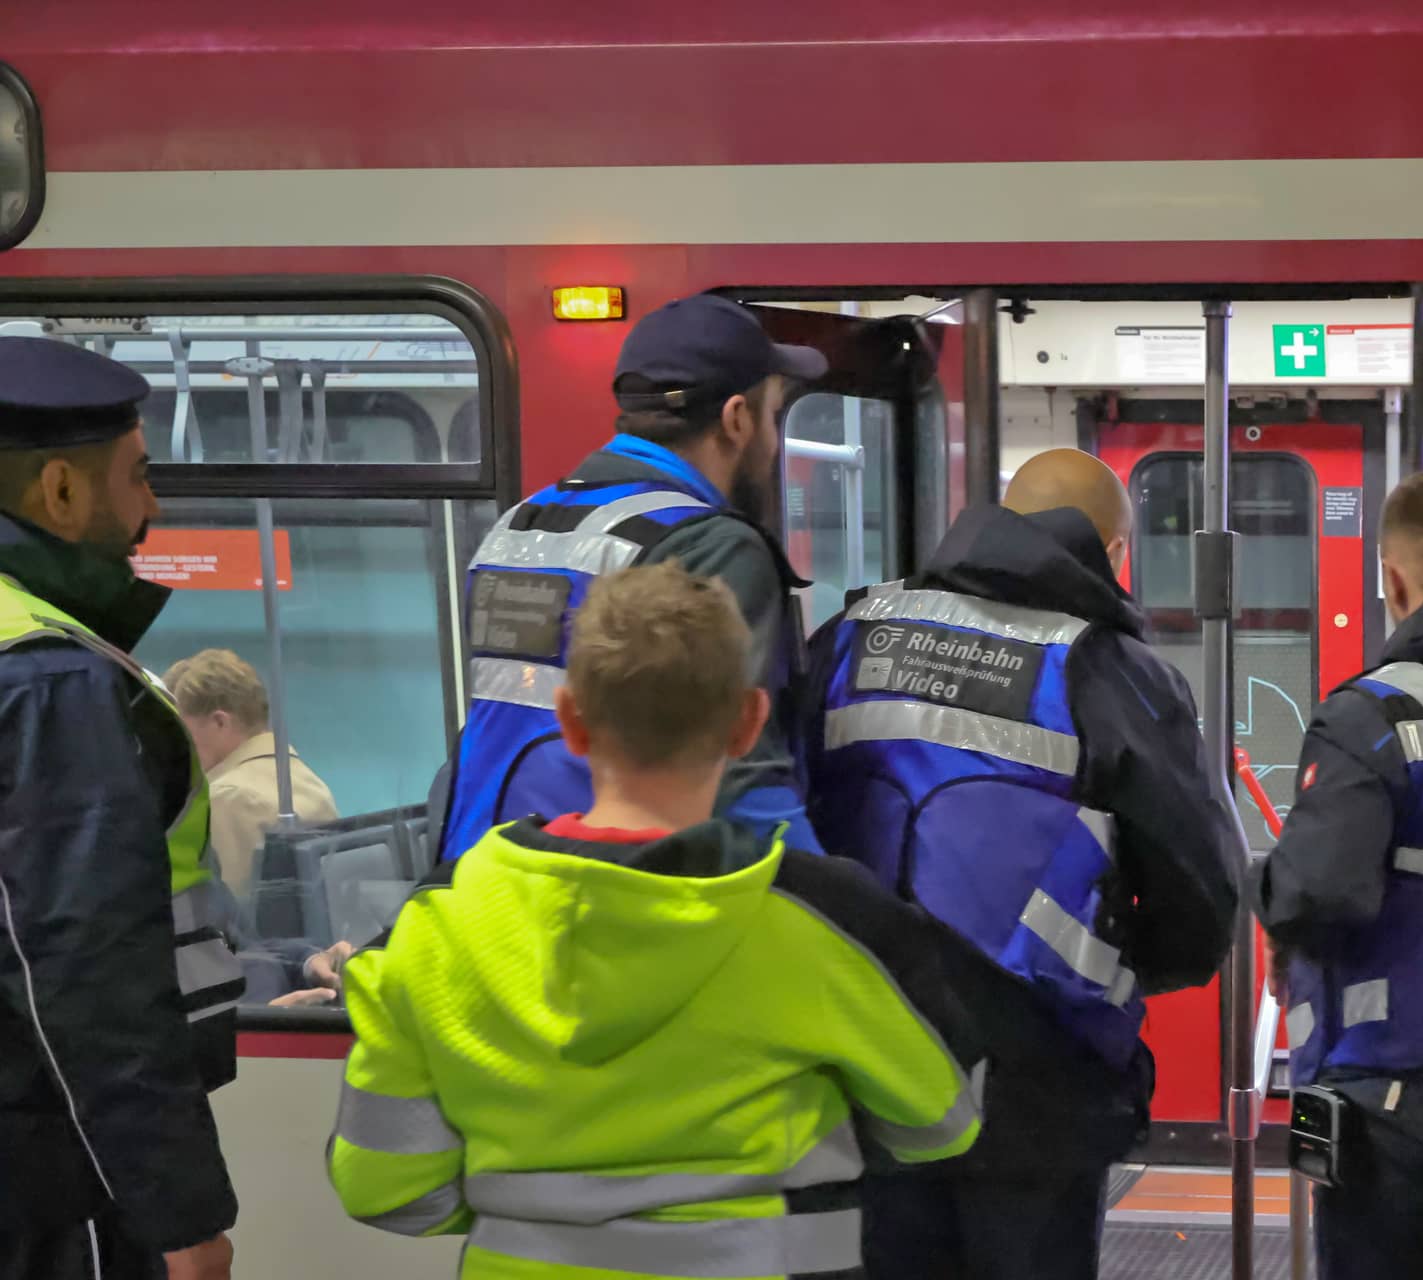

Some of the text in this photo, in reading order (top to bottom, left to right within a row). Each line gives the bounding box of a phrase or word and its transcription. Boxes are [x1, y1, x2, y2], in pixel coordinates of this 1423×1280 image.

[907, 632, 1024, 671] Rheinbahn
[896, 670, 959, 699] Video
[902, 655, 1013, 687] Fahrausweisprüfung
